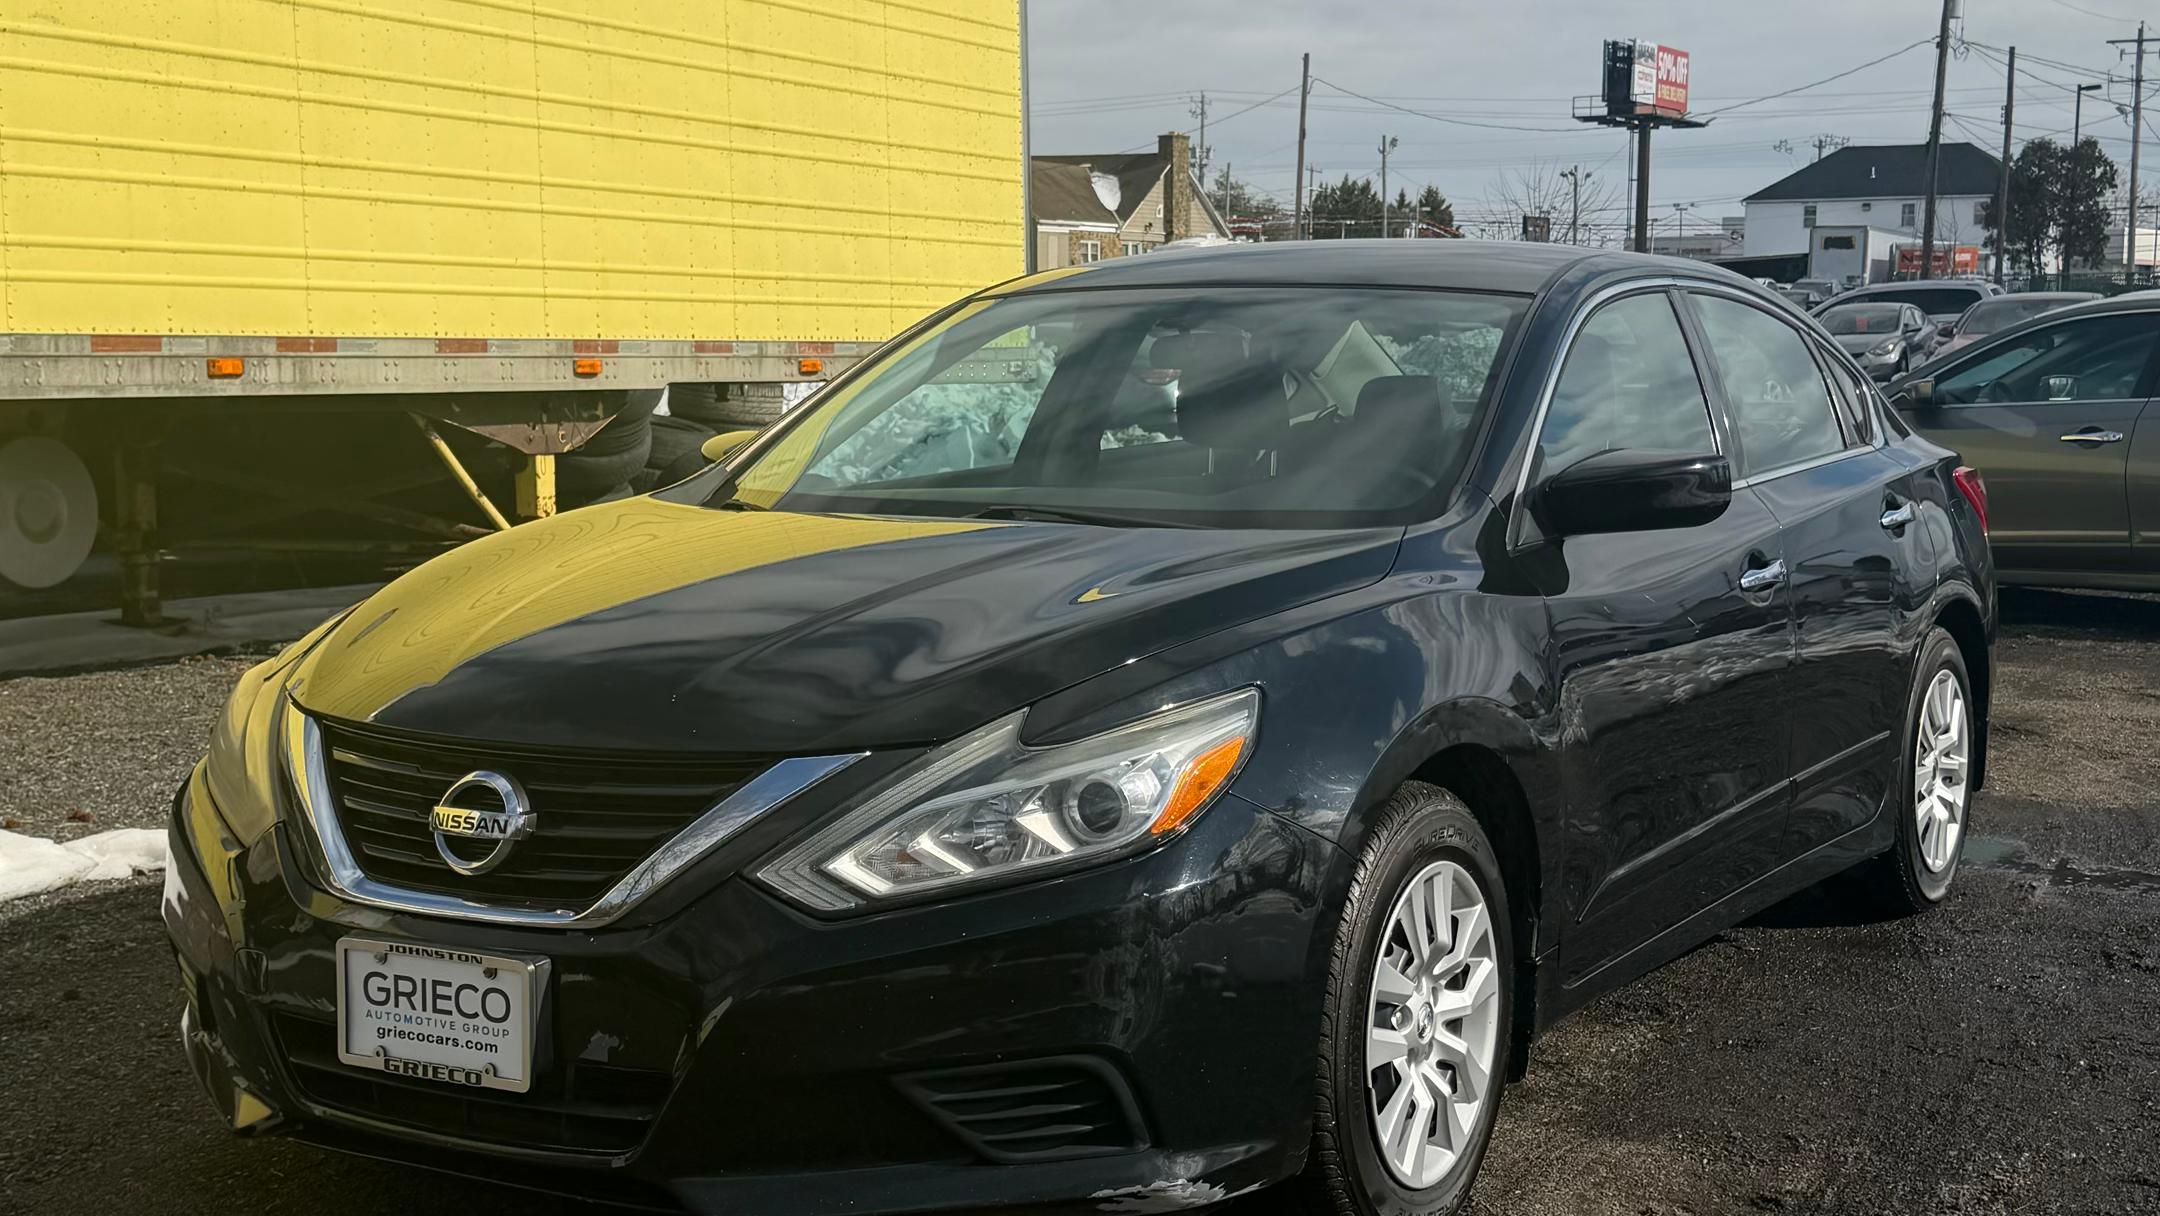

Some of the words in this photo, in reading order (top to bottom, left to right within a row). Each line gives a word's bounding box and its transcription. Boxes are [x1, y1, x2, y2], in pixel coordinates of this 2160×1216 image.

[1658, 51, 1676, 81] 50%
[1676, 57, 1688, 85] OFF
[434, 812, 508, 834] NISSAN
[384, 944, 483, 964] JOHNSTON
[363, 971, 511, 1023] GRIECO
[365, 1009, 456, 1030] AUTOMOTIVE
[462, 1023, 510, 1039] GROUP
[377, 1026, 498, 1053] griecocars.com
[384, 1058, 482, 1086] GRIECO
